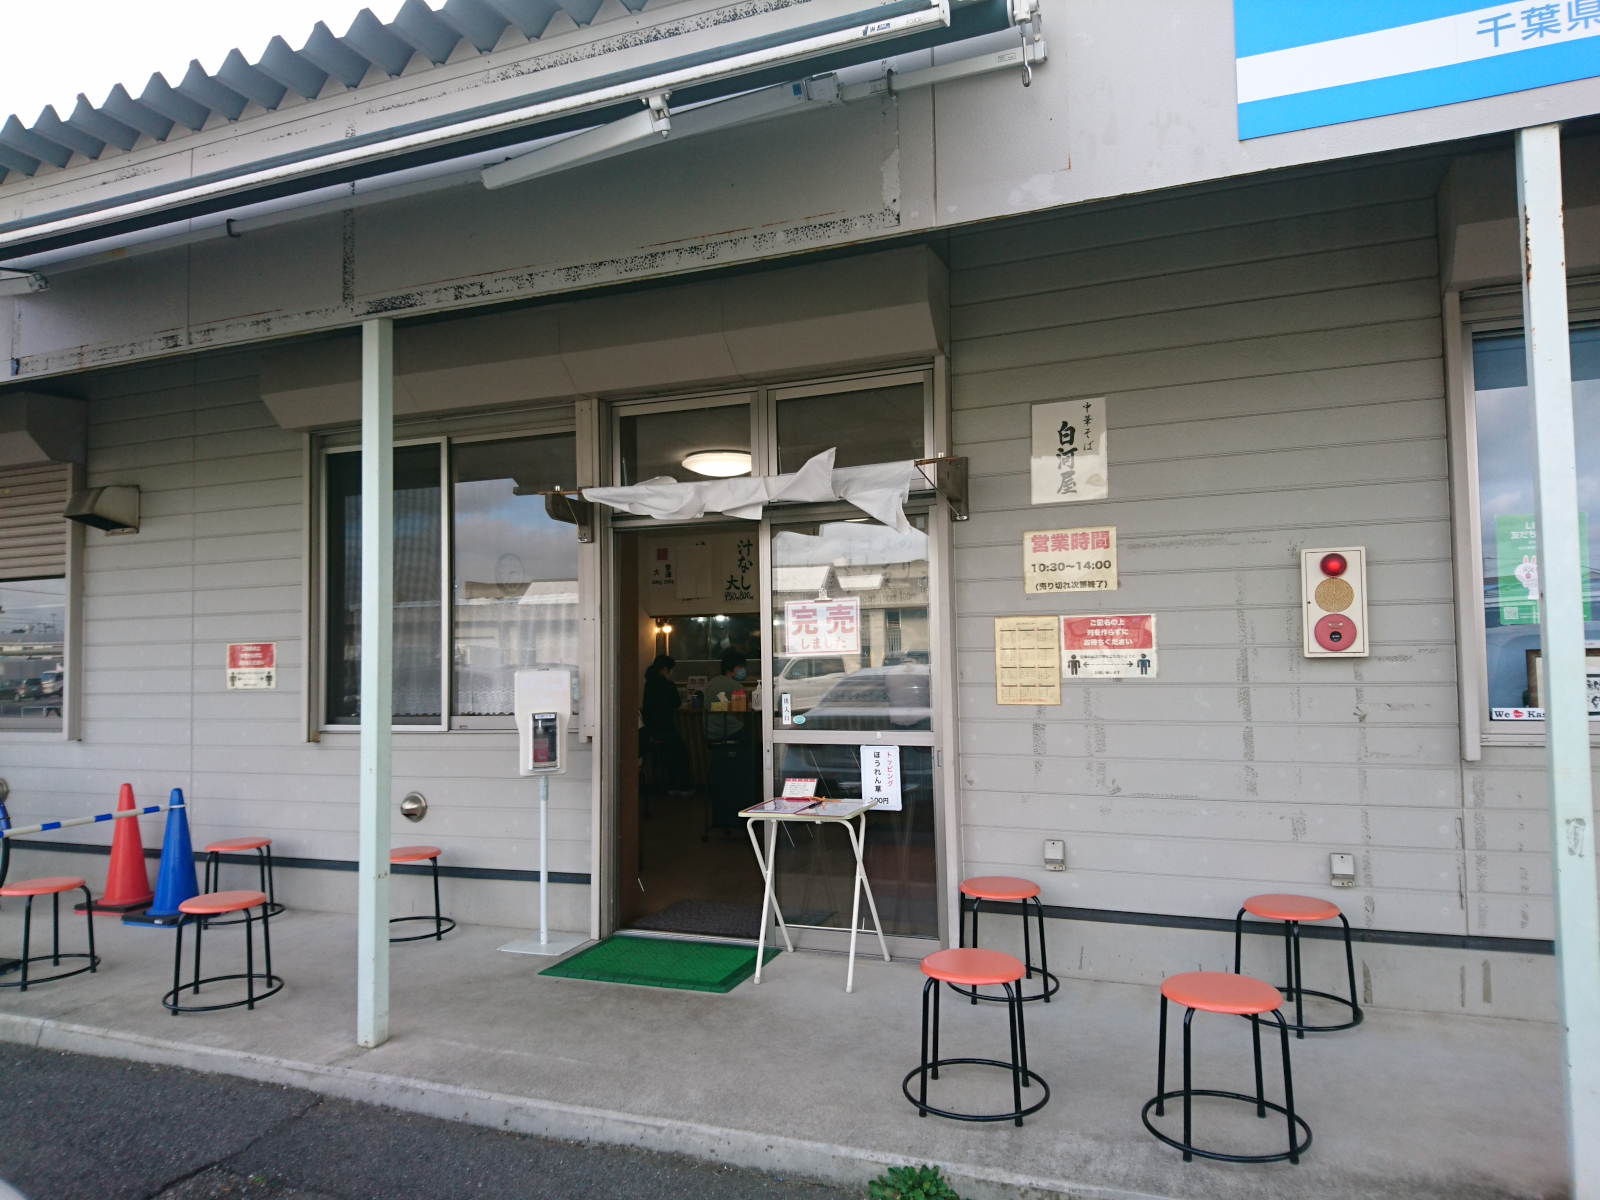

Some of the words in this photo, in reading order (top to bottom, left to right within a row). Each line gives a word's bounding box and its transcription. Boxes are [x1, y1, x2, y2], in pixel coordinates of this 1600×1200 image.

[1082, 401, 1094, 451] 中華そば
[1055, 420, 1078, 495] 白河屋
[1525, 521, 1536, 530] LI
[1030, 530, 1110, 553] 営業時間
[1510, 530, 1536, 540] 友だち
[656, 547, 669, 561] 麺
[737, 538, 754, 591] 汁なし
[725, 574, 741, 591] 大
[791, 604, 855, 636] 完売
[1086, 629, 1129, 637] 列を作らずに
[801, 636, 846, 650] しました
[1083, 638, 1133, 646] お待ちください
[1494, 710, 1510, 718] We
[873, 751, 882, 793] ほうれん草
